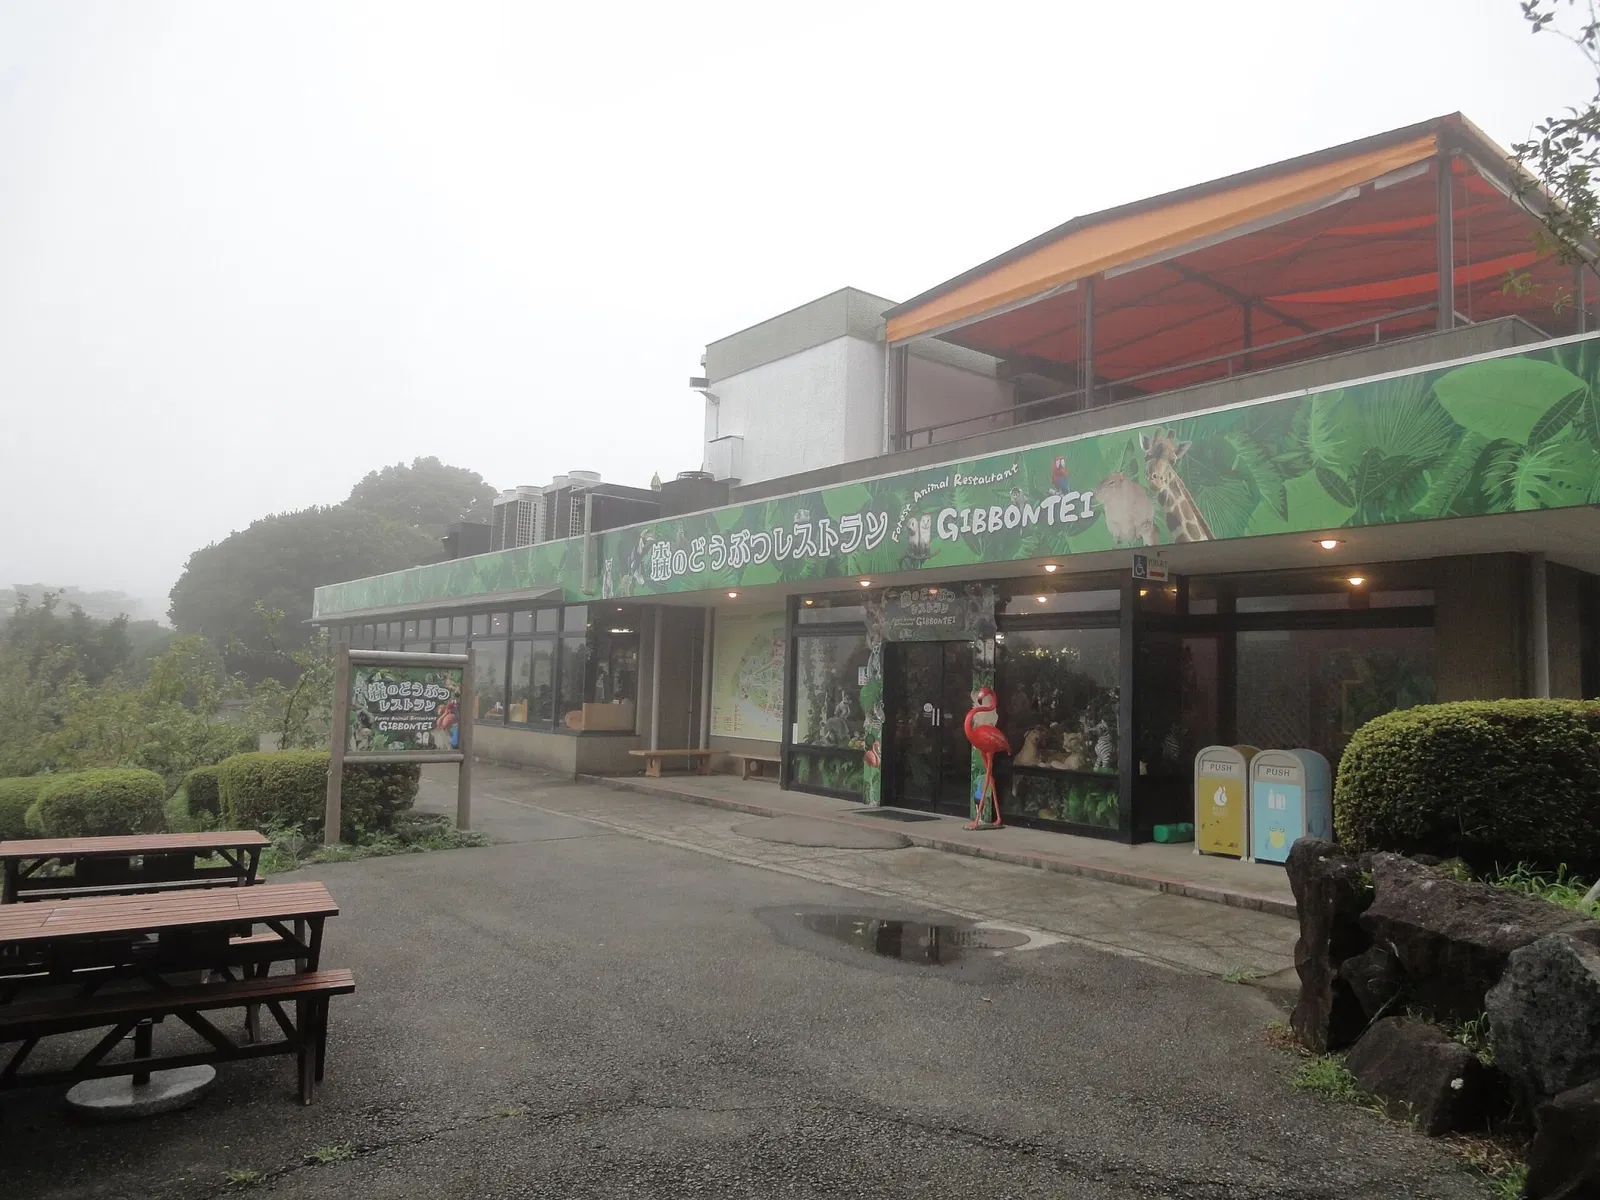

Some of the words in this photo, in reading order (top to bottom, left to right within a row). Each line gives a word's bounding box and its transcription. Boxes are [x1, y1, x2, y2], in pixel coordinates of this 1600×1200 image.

[891, 503, 912, 543] Forest
[913, 476, 950, 503] Animal
[953, 463, 1019, 487] Restaurant
[936, 491, 1095, 542] GIBBONTEI
[650, 511, 889, 582] 森のどうぶつレストラン
[916, 616, 957, 626] GIBBONTEI
[368, 681, 450, 702] 森のどうぶつ
[379, 698, 436, 712] レストラン
[379, 721, 433, 731] GIBBONTEI
[1210, 763, 1232, 772] PUSH
[1266, 768, 1290, 777] PUSH
